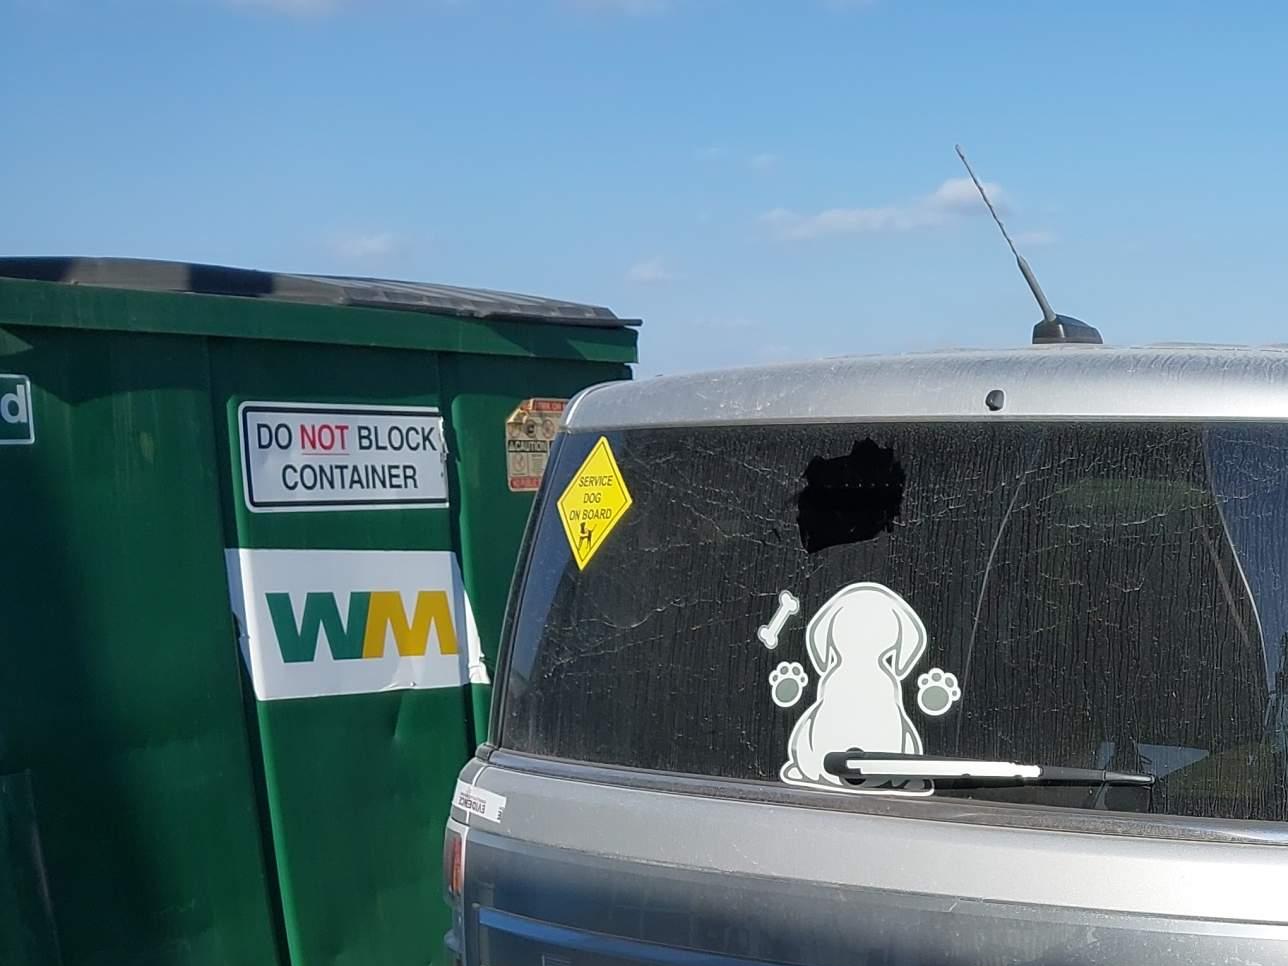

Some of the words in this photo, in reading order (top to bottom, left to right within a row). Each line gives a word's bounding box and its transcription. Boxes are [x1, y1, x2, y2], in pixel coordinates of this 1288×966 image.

[256, 423, 292, 450] DO
[300, 424, 349, 451] NOT
[357, 426, 437, 451] BLOCK
[282, 464, 418, 491] CONTAINER
[578, 475, 613, 487] SERVICE
[584, 492, 602, 504] DOG
[570, 511, 580, 520] ON
[582, 508, 612, 520] BOARD
[265, 590, 460, 663] WM
